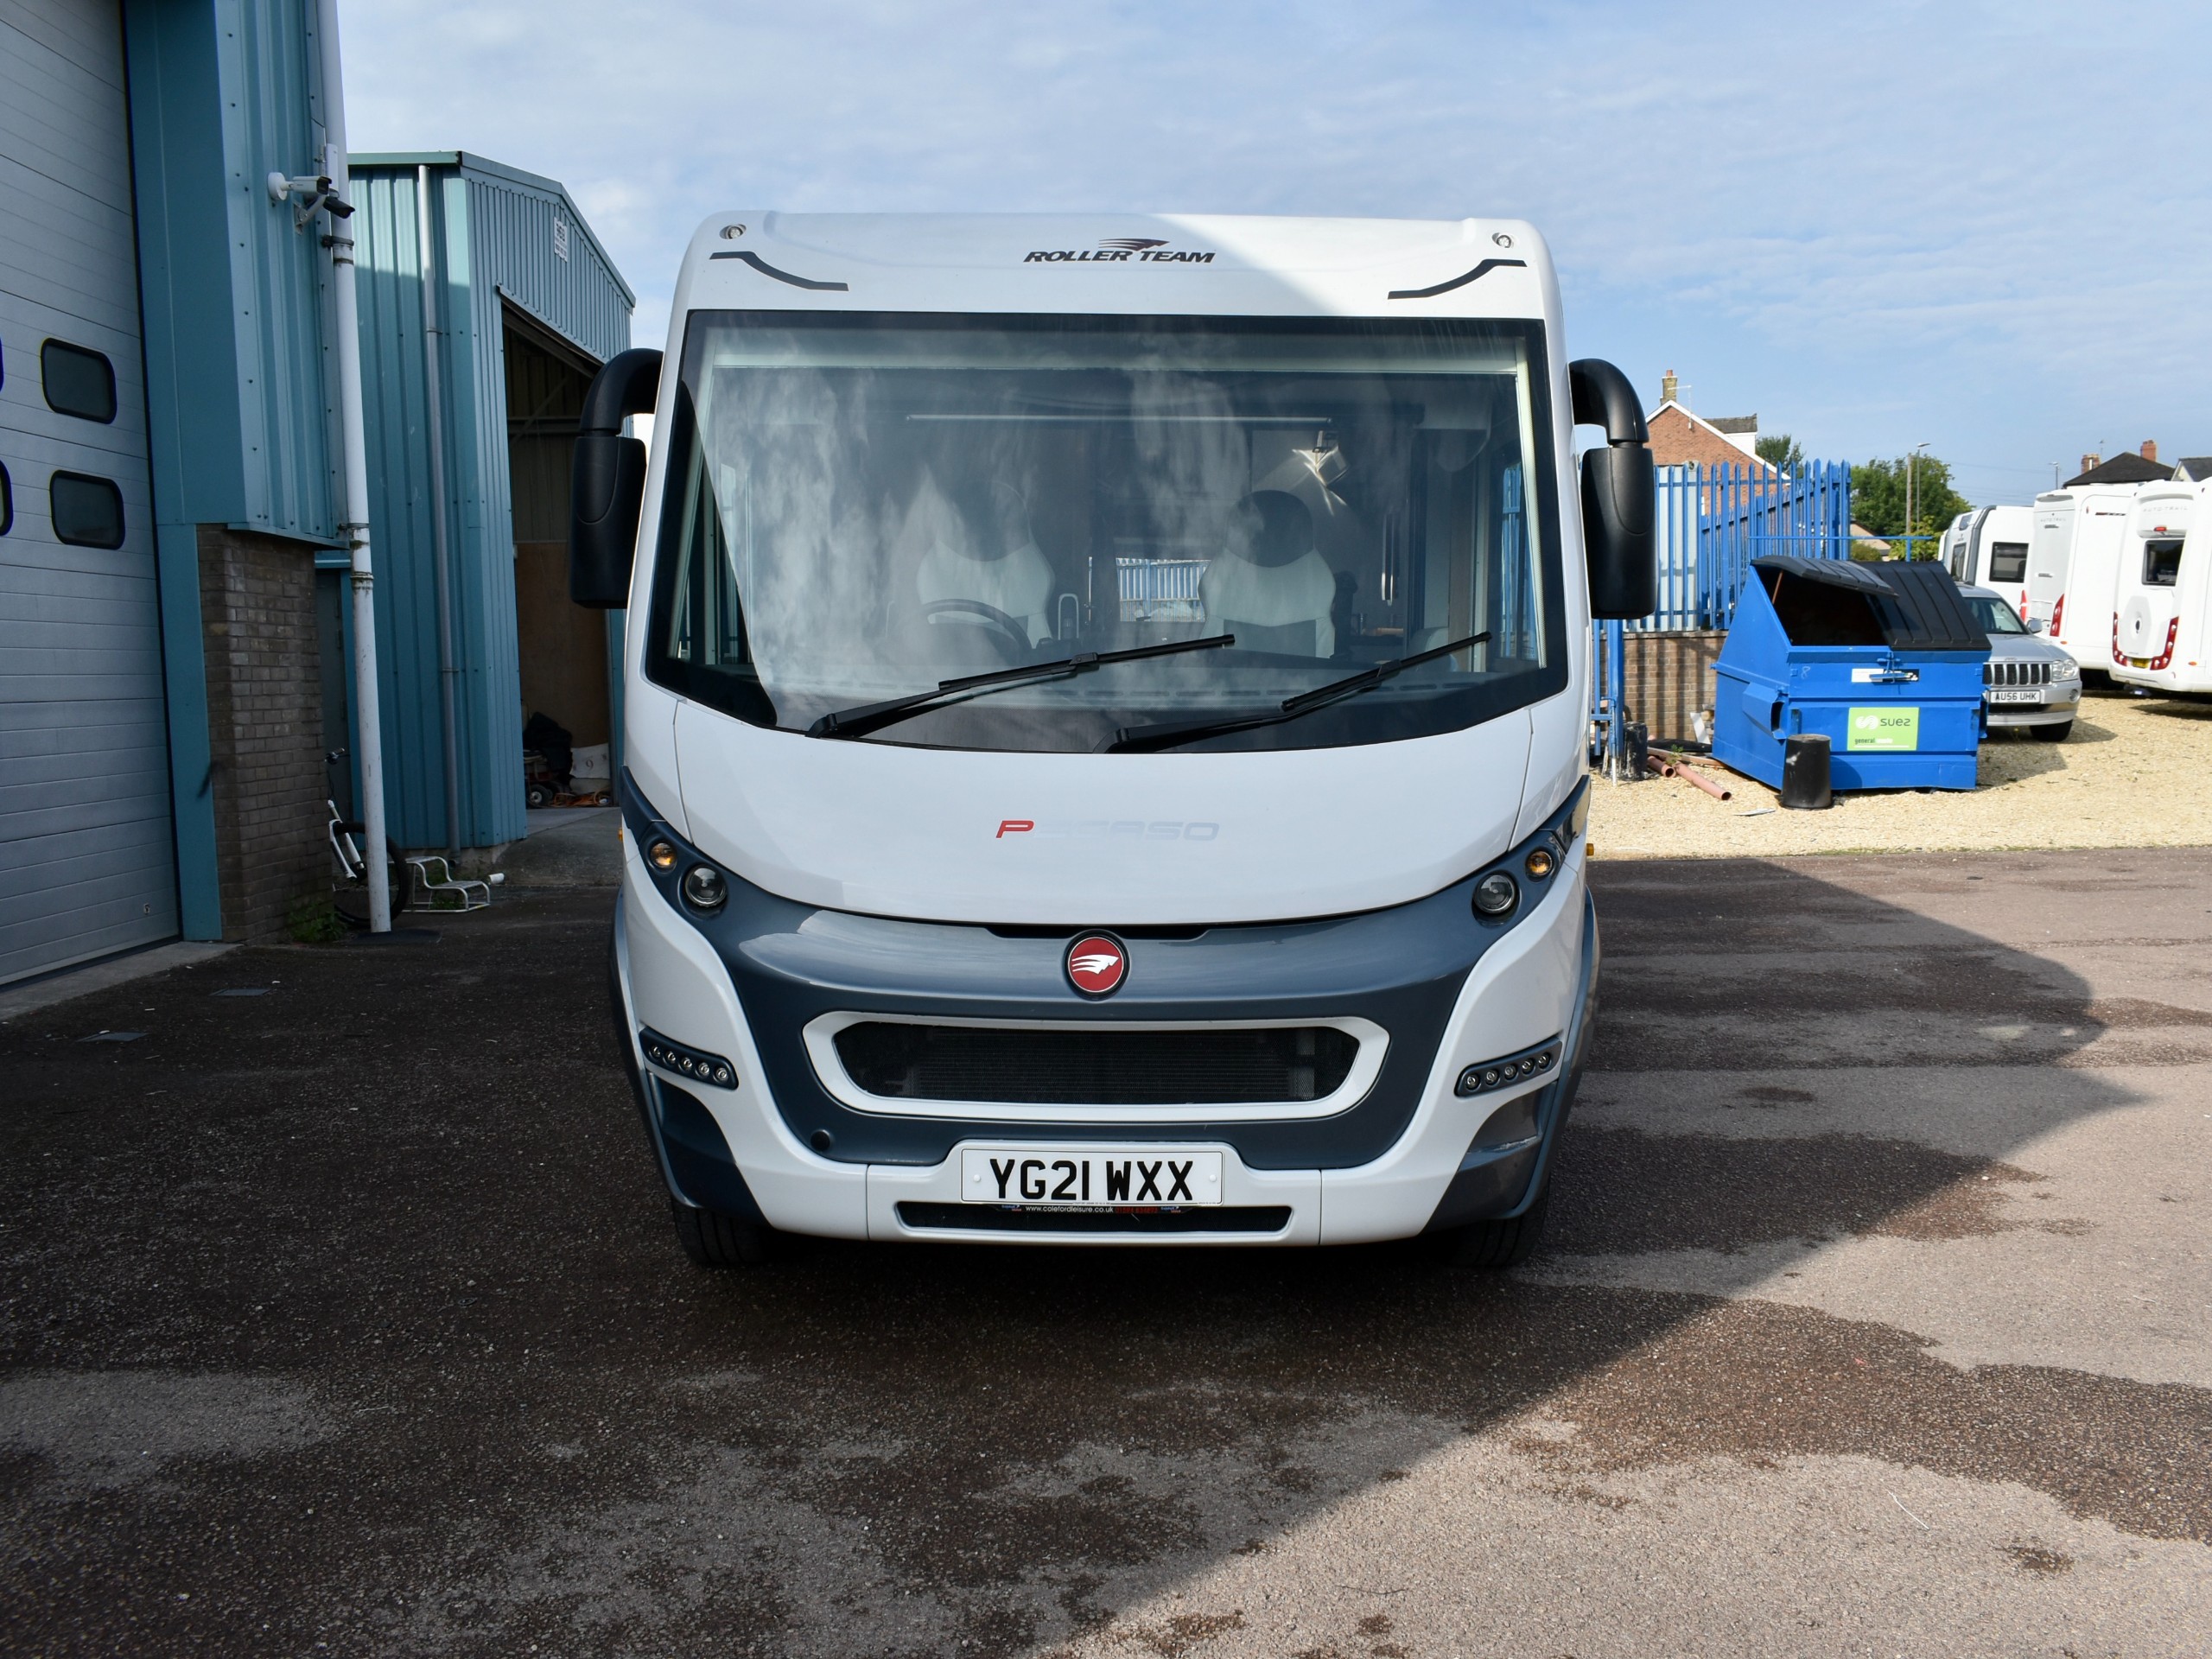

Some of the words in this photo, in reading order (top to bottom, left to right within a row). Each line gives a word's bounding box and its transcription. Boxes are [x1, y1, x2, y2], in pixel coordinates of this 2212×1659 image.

[1023, 251, 1133, 262] ROLLER
[1140, 251, 1216, 263] TEAM
[1995, 692, 2018, 701] AU56
[2019, 692, 2037, 701] UHK
[1879, 718, 1910, 727] suez
[989, 1159, 1090, 1200] YG21
[1105, 1160, 1193, 1200] WXX
